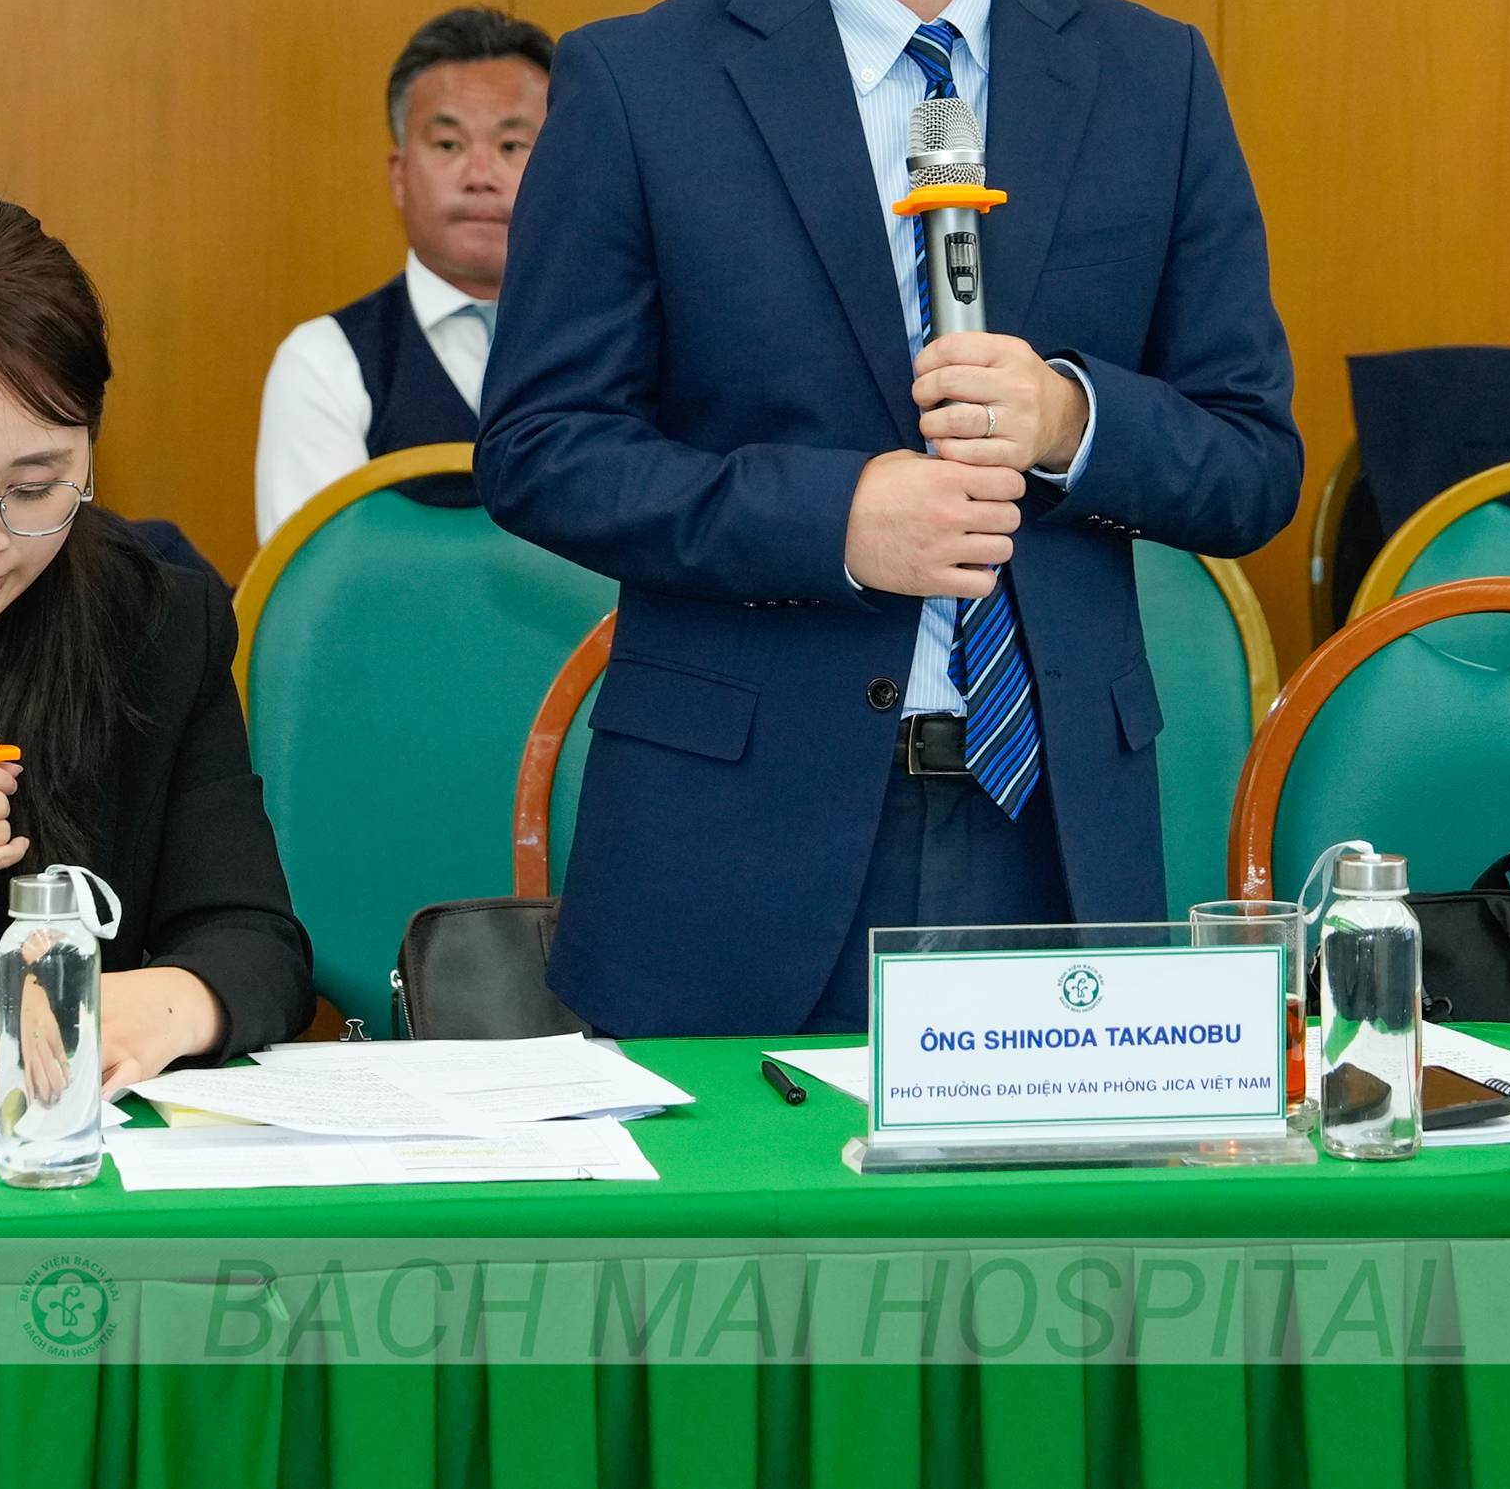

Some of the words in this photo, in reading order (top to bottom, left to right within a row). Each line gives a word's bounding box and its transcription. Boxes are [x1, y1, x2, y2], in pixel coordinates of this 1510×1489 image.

[920, 1026, 976, 1053] ÔNG
[984, 1027, 1098, 1051] SHINODA
[1105, 1023, 1242, 1047] TAKANOBU
[891, 1082, 923, 1099] PHÓ
[927, 1080, 992, 1098] TRƯỞNG
[997, 1082, 1022, 1099] ĐẠI
[1027, 1079, 1062, 1098] DIỆN
[1068, 1078, 1098, 1094] VĂN
[1104, 1077, 1157, 1093] PHÒNG
[1162, 1078, 1196, 1092] JICA
[1201, 1074, 1234, 1093] VIỆT
[1239, 1076, 1271, 1089] NAM
